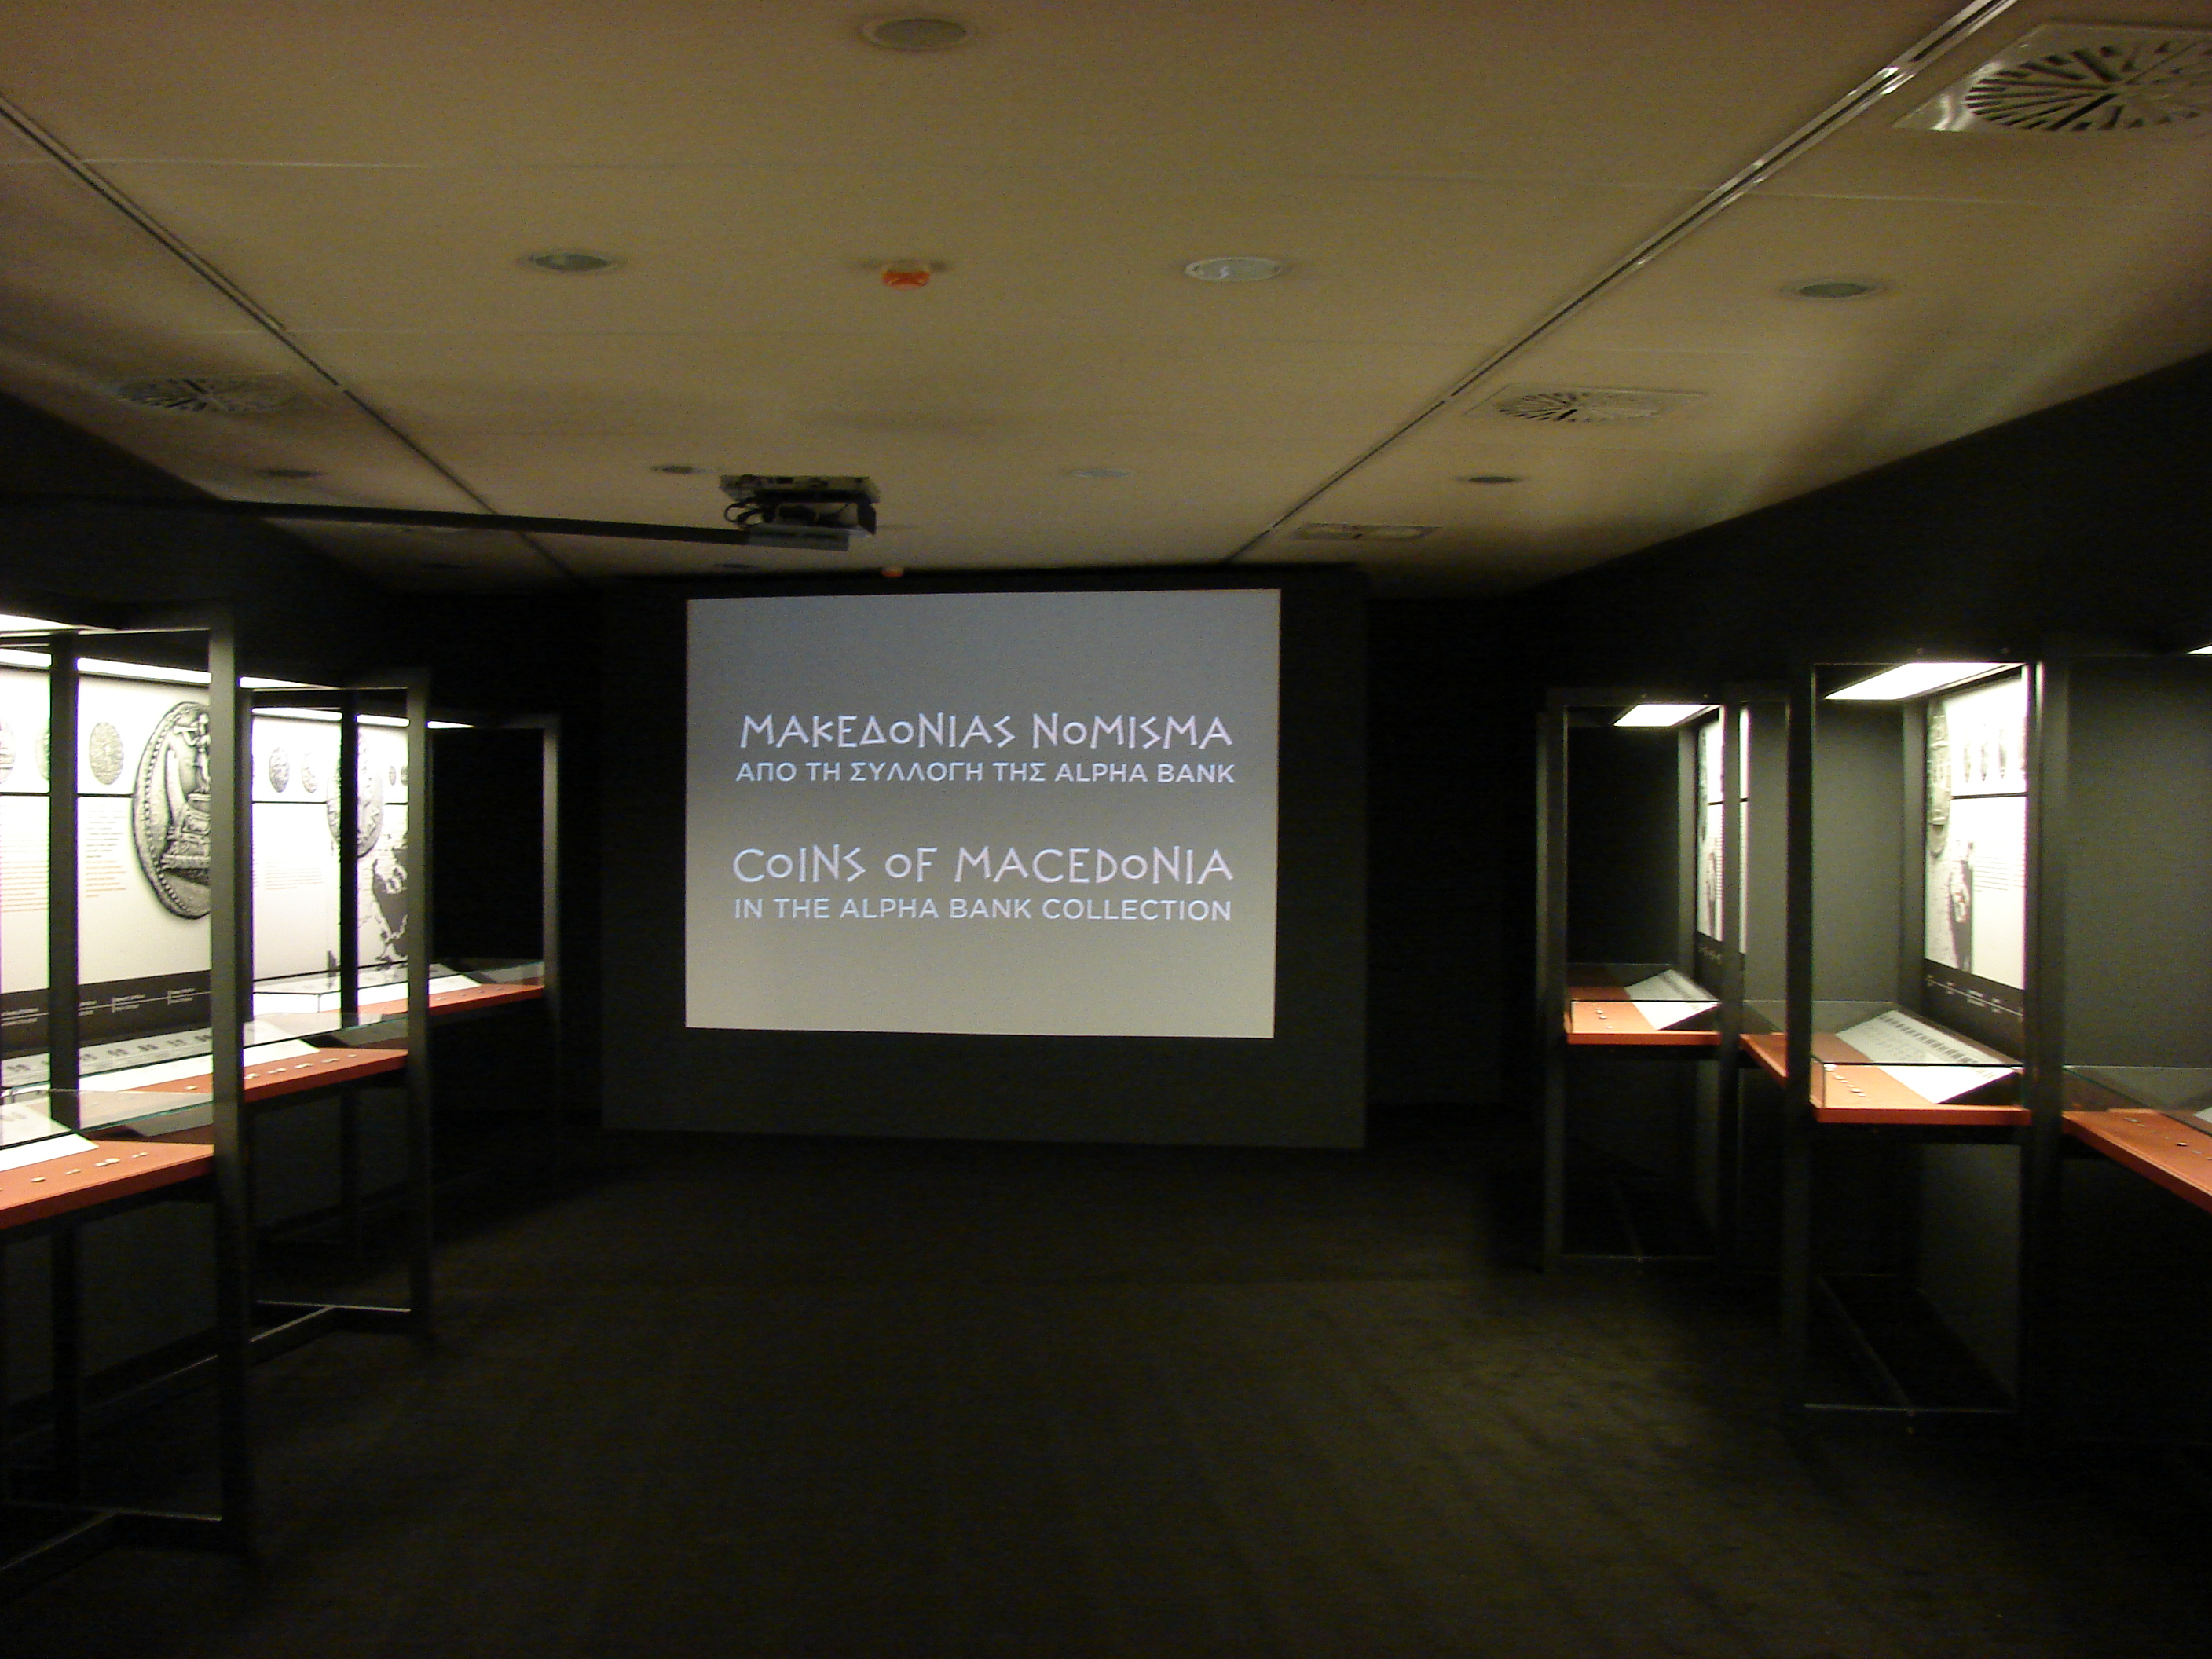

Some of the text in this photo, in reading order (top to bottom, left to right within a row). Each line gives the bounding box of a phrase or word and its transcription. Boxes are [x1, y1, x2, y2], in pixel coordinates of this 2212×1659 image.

[735, 761, 1236, 784] ΑΠΟ ΤΗ ΣΥΛΛΟΓΗ ΤΗΣ ALPHA BANK
[734, 897, 1232, 921] IN THE ALPHA BANK COLLECTION
